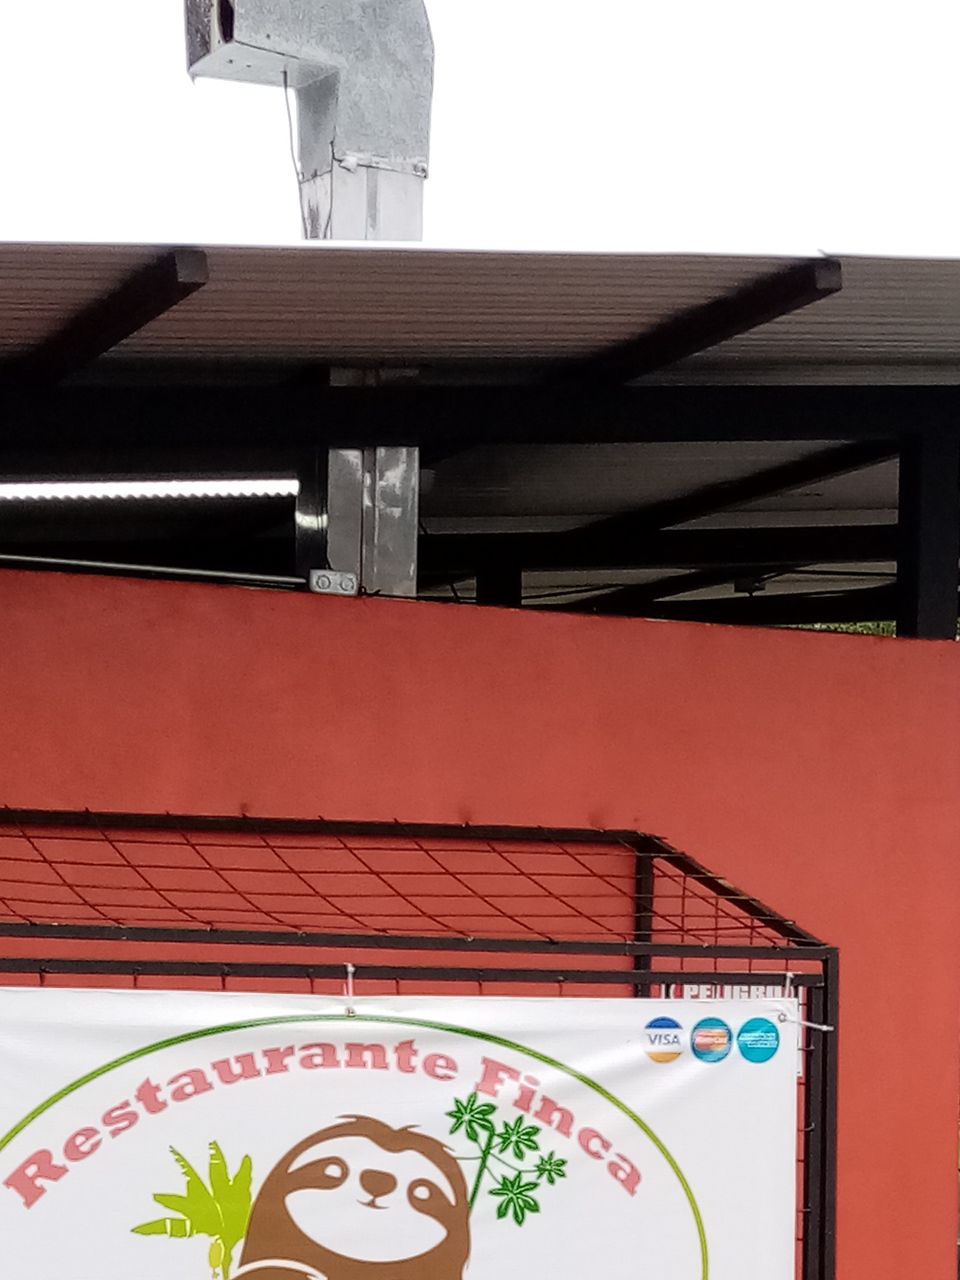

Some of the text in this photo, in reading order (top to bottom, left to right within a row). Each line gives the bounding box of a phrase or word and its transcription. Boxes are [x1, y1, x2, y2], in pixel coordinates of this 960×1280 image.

[648, 1033, 681, 1046] VISA
[3, 1039, 642, 1209] Restaurante Finca
